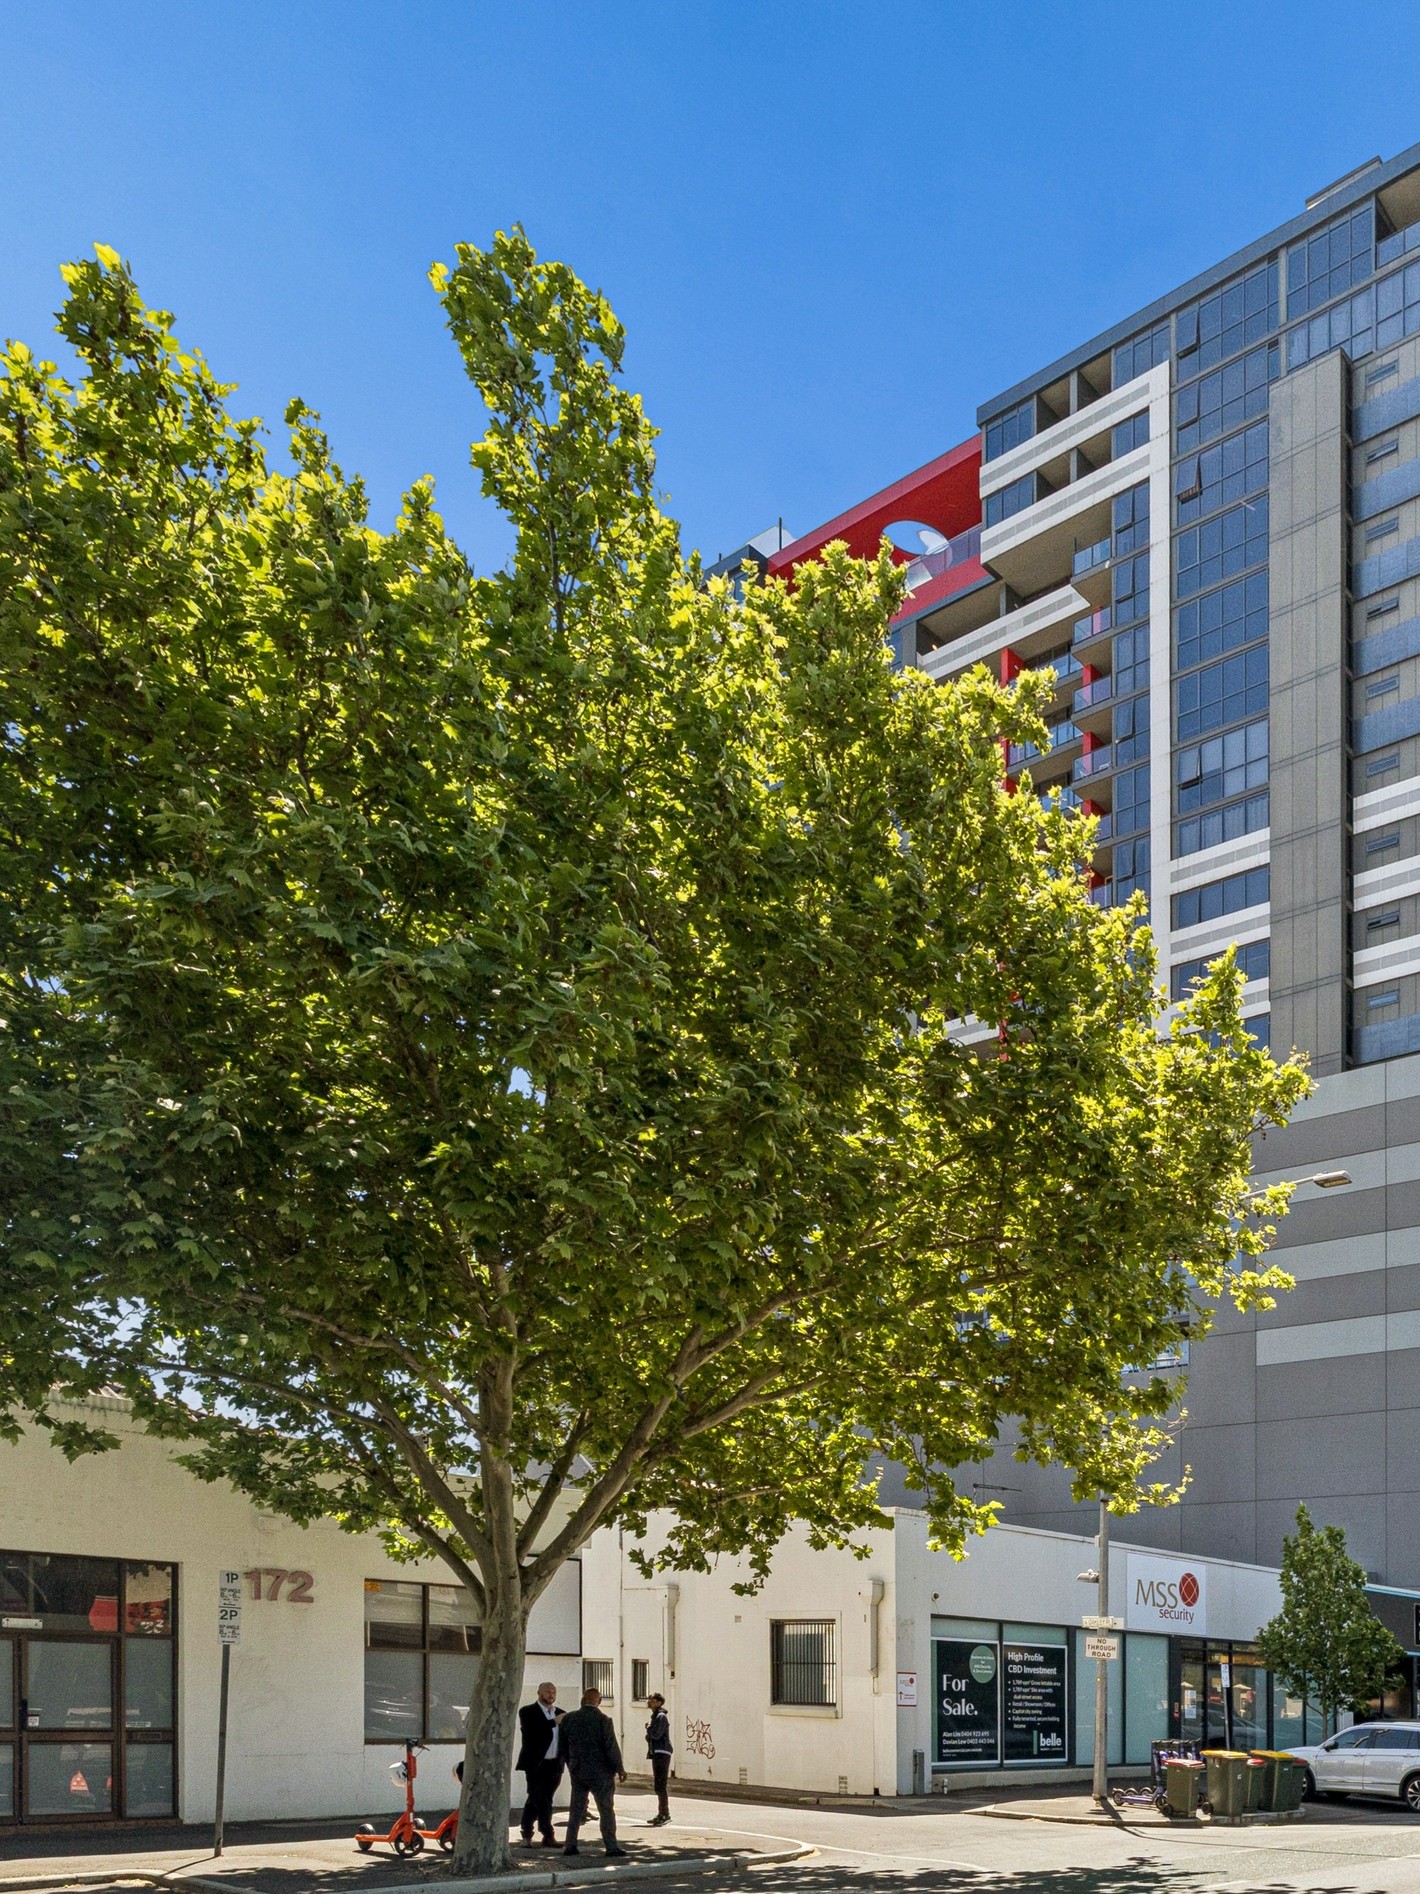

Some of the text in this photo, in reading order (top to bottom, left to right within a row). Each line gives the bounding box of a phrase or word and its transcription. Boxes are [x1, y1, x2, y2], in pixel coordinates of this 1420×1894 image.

[225, 1572, 239, 1583] 1P
[243, 1568, 314, 1603] 172
[1135, 1579, 1178, 1609] MSS
[219, 1609, 238, 1620] 2P
[1159, 1608, 1195, 1624] security
[1007, 1652, 1044, 1662] High Profile
[1008, 1665, 1057, 1675] CBD Investment
[942, 1674, 970, 1691] For
[942, 1698, 978, 1716] Sale.
[1040, 1732, 1062, 1746] belle
